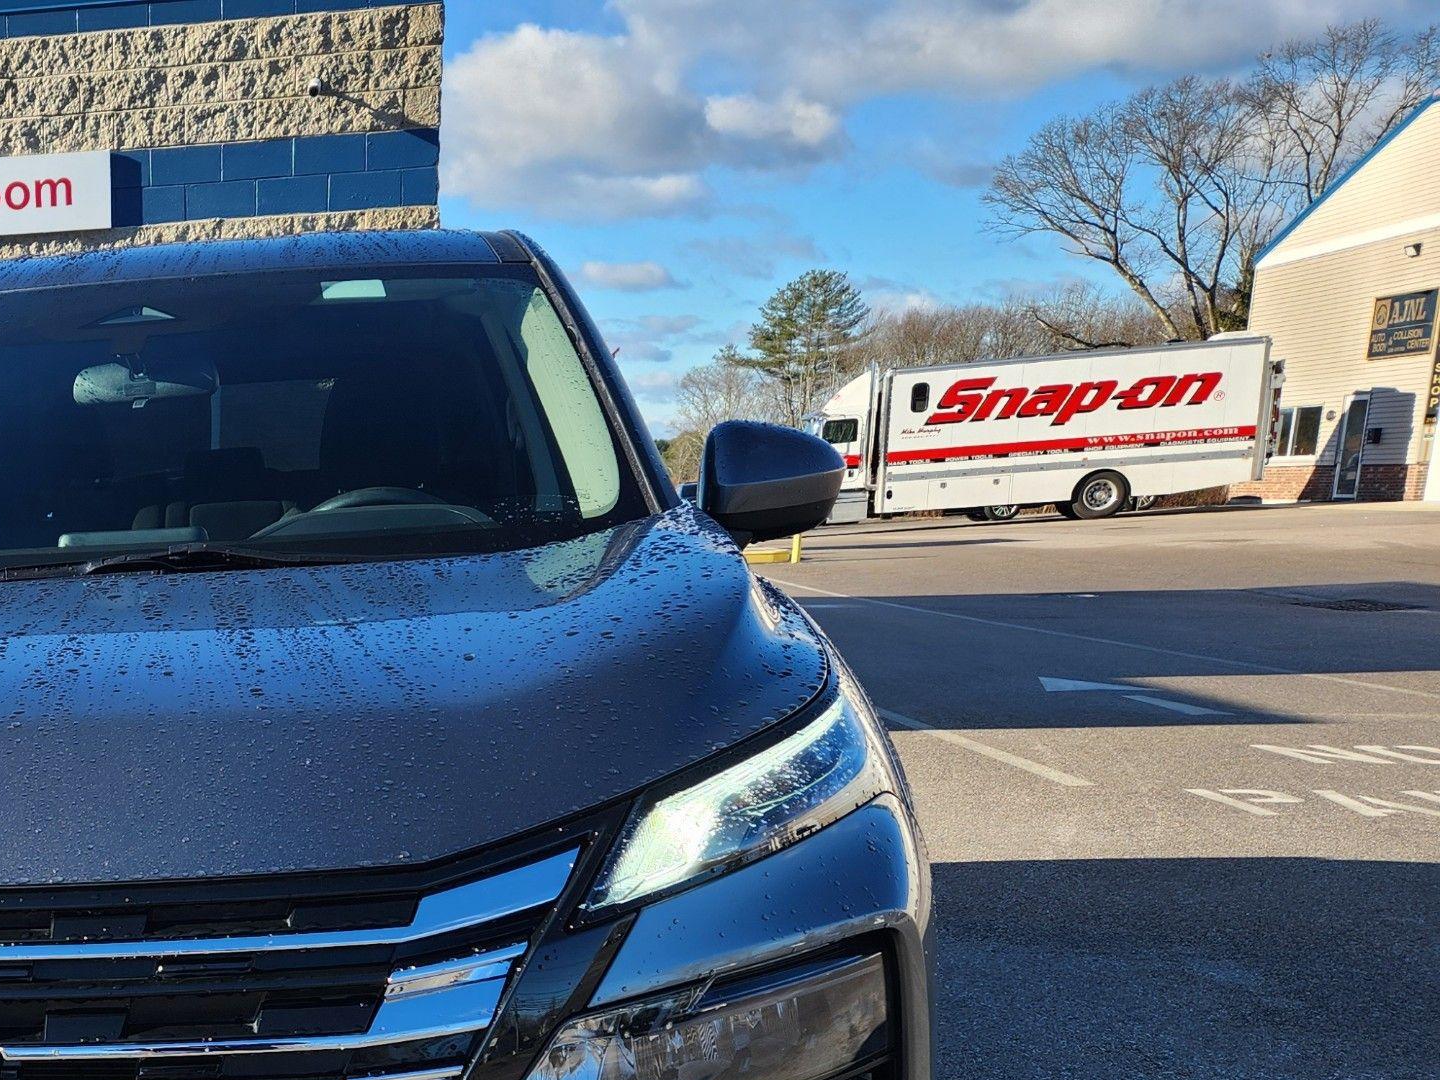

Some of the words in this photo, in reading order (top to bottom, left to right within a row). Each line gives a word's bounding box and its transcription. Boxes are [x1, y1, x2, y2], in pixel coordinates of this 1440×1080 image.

[1389, 297, 1427, 325] AJNL
[1371, 333, 1386, 343] AUTO
[1393, 328, 1424, 340] COLLISION
[1407, 338, 1430, 349] CENTER
[924, 371, 1223, 426] Snap-on
[1087, 427, 1240, 444] www.snapon.com
[1160, 439, 1205, 447] DIAGNOSTIC
[1206, 435, 1250, 443] EQUIPMENT
[1008, 450, 1045, 458] SPECIALTY
[1046, 448, 1070, 456] TOOLS
